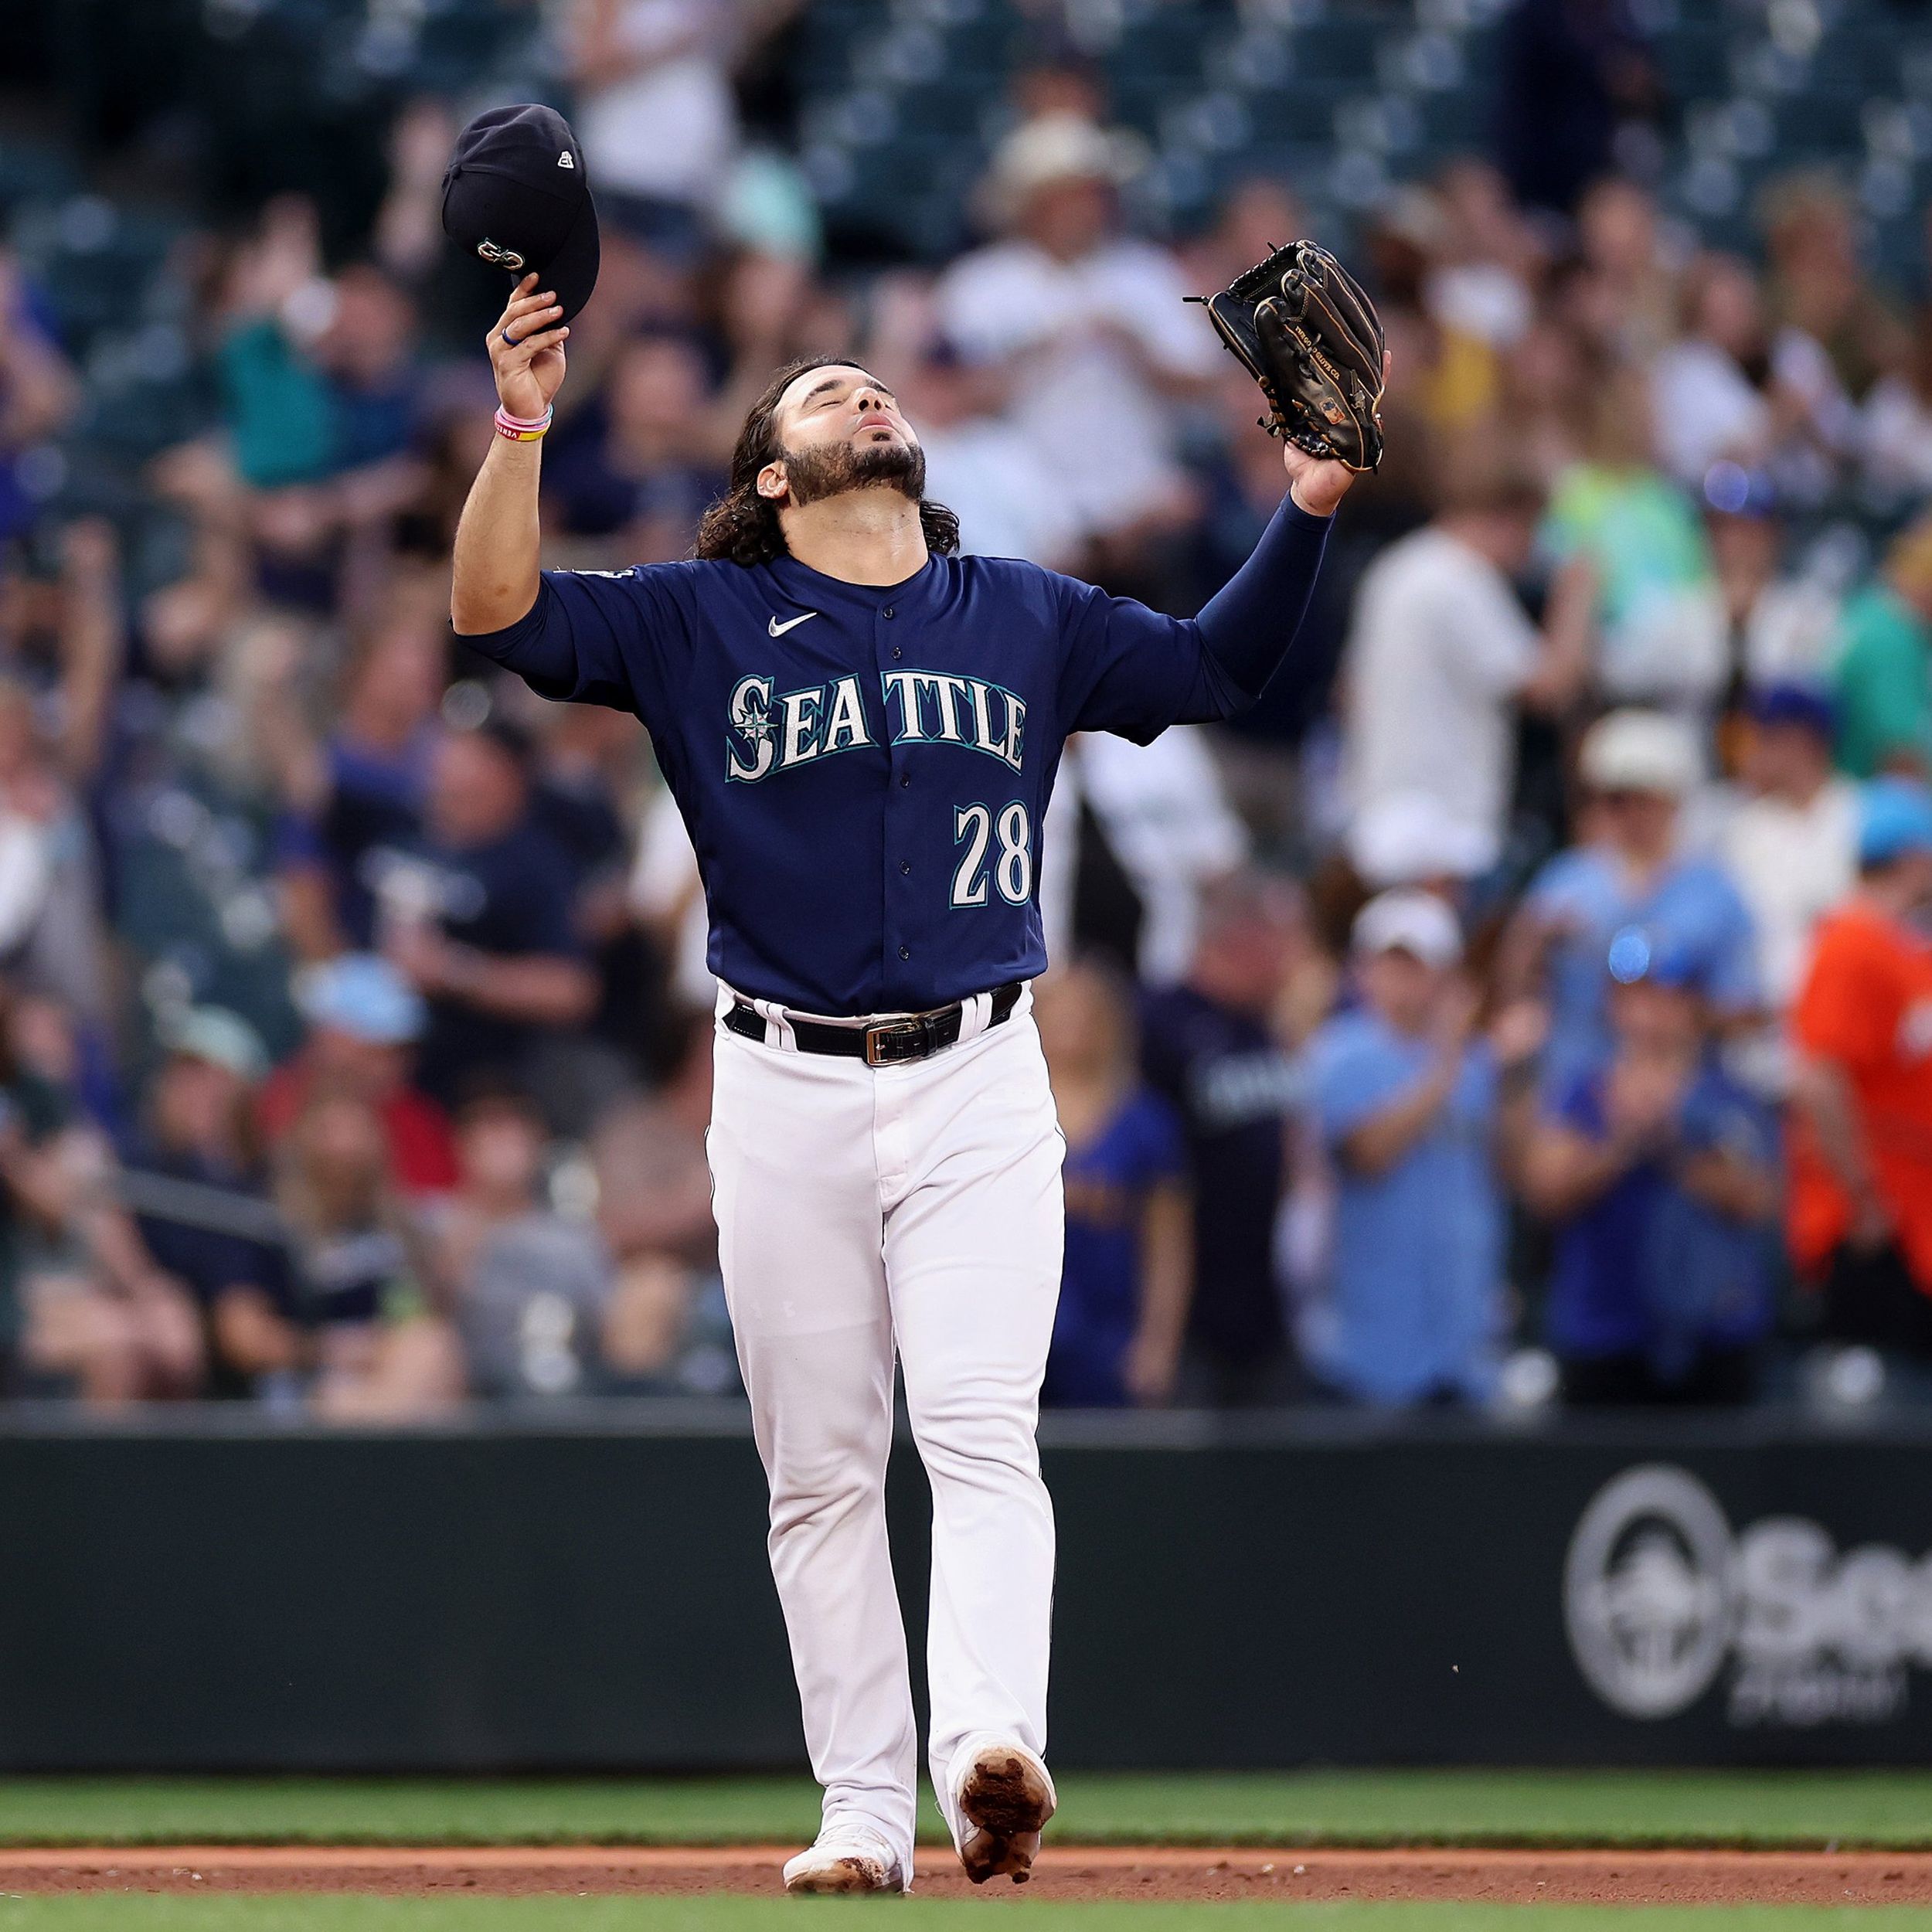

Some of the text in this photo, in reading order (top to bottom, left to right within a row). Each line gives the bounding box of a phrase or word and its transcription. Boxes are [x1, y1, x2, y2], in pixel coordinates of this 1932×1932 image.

[1304, 336, 1318, 353] GOD
[1315, 352, 1332, 372] GLOVE
[725, 668, 1027, 784] SEATTLE
[949, 799, 1032, 910] 28
